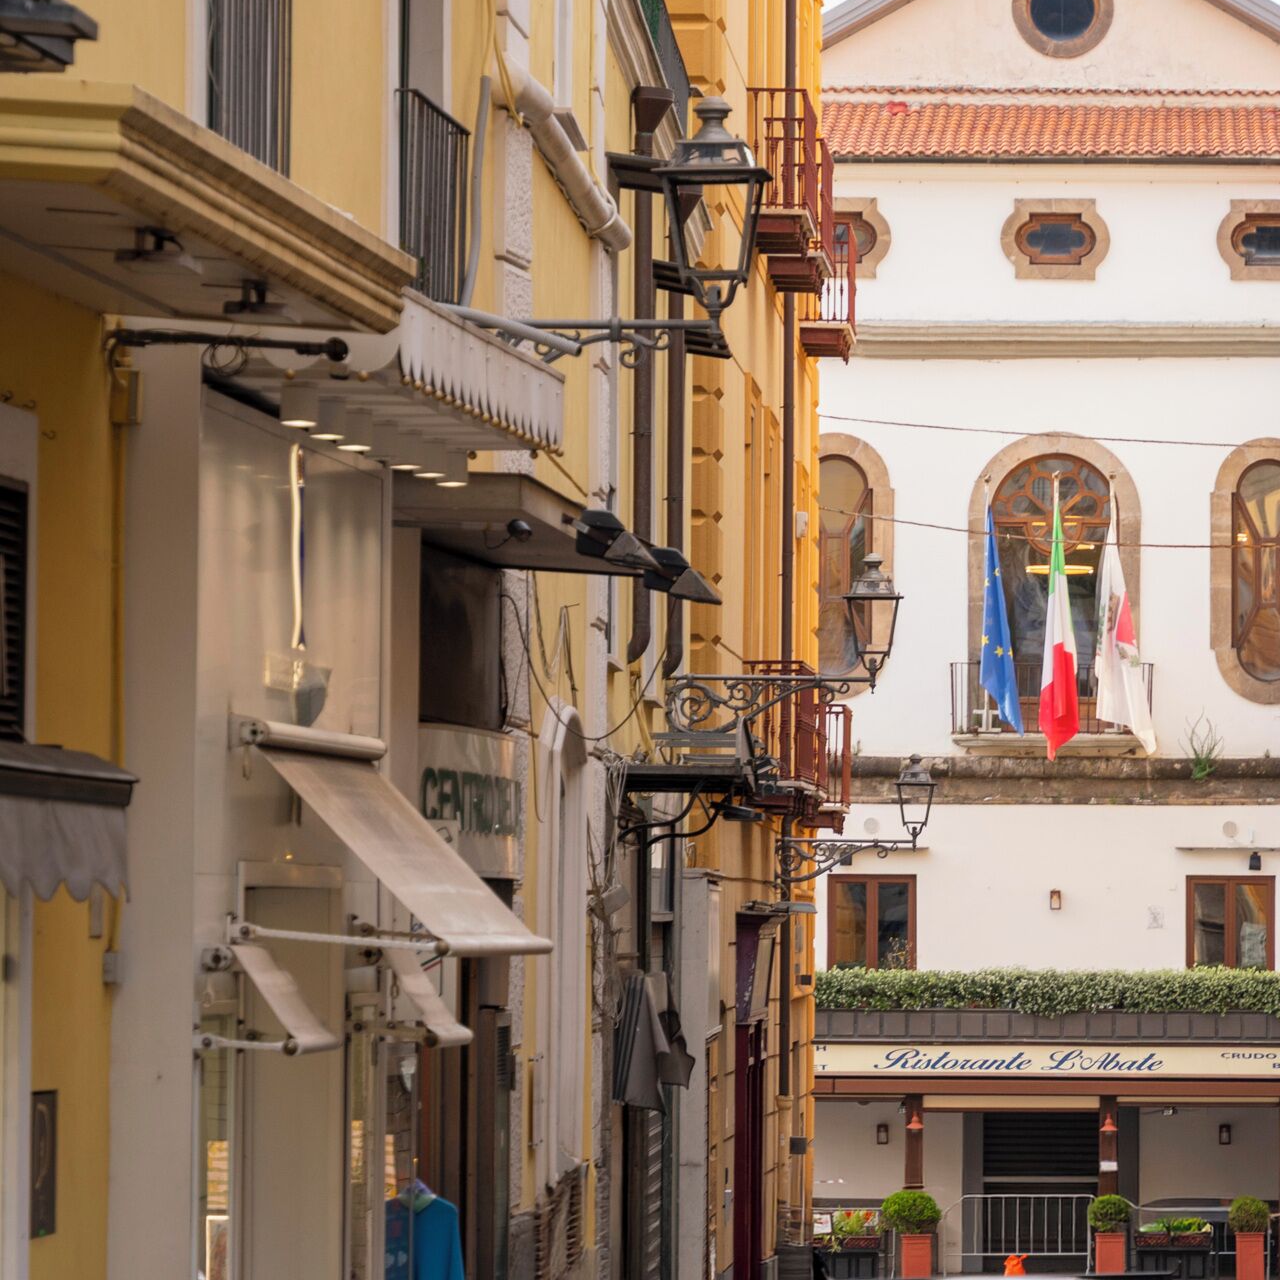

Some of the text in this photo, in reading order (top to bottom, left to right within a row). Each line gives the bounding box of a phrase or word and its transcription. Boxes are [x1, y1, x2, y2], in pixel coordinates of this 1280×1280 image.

[873, 1047, 1164, 1072] Ristorante L'Abate
[1220, 1052, 1277, 1061] CRUDO
